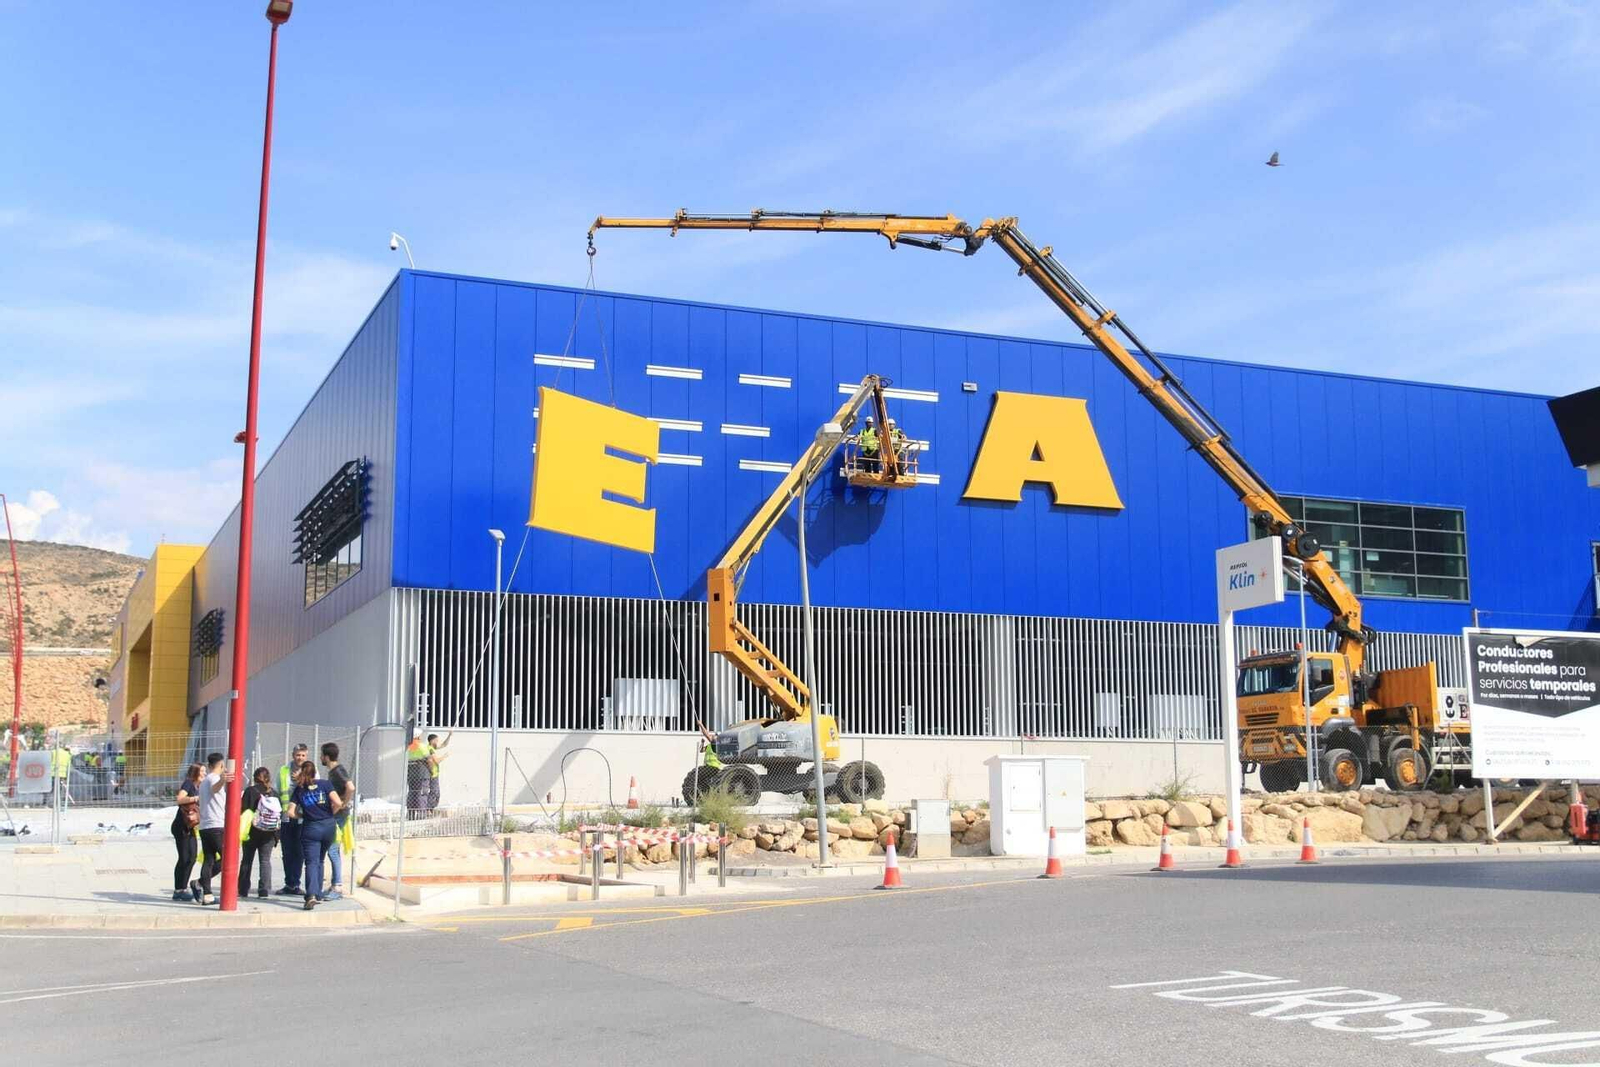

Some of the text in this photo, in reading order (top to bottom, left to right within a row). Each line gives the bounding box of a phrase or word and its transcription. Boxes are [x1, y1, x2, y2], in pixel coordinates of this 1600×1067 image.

[962, 390, 1126, 510] A
[525, 386, 660, 554] E
[1229, 571, 1255, 591] Klin
[1477, 645, 1553, 659] Conductores
[1478, 660, 1586, 678] Profesionales para
[1479, 677, 1596, 695] servicios temporales
